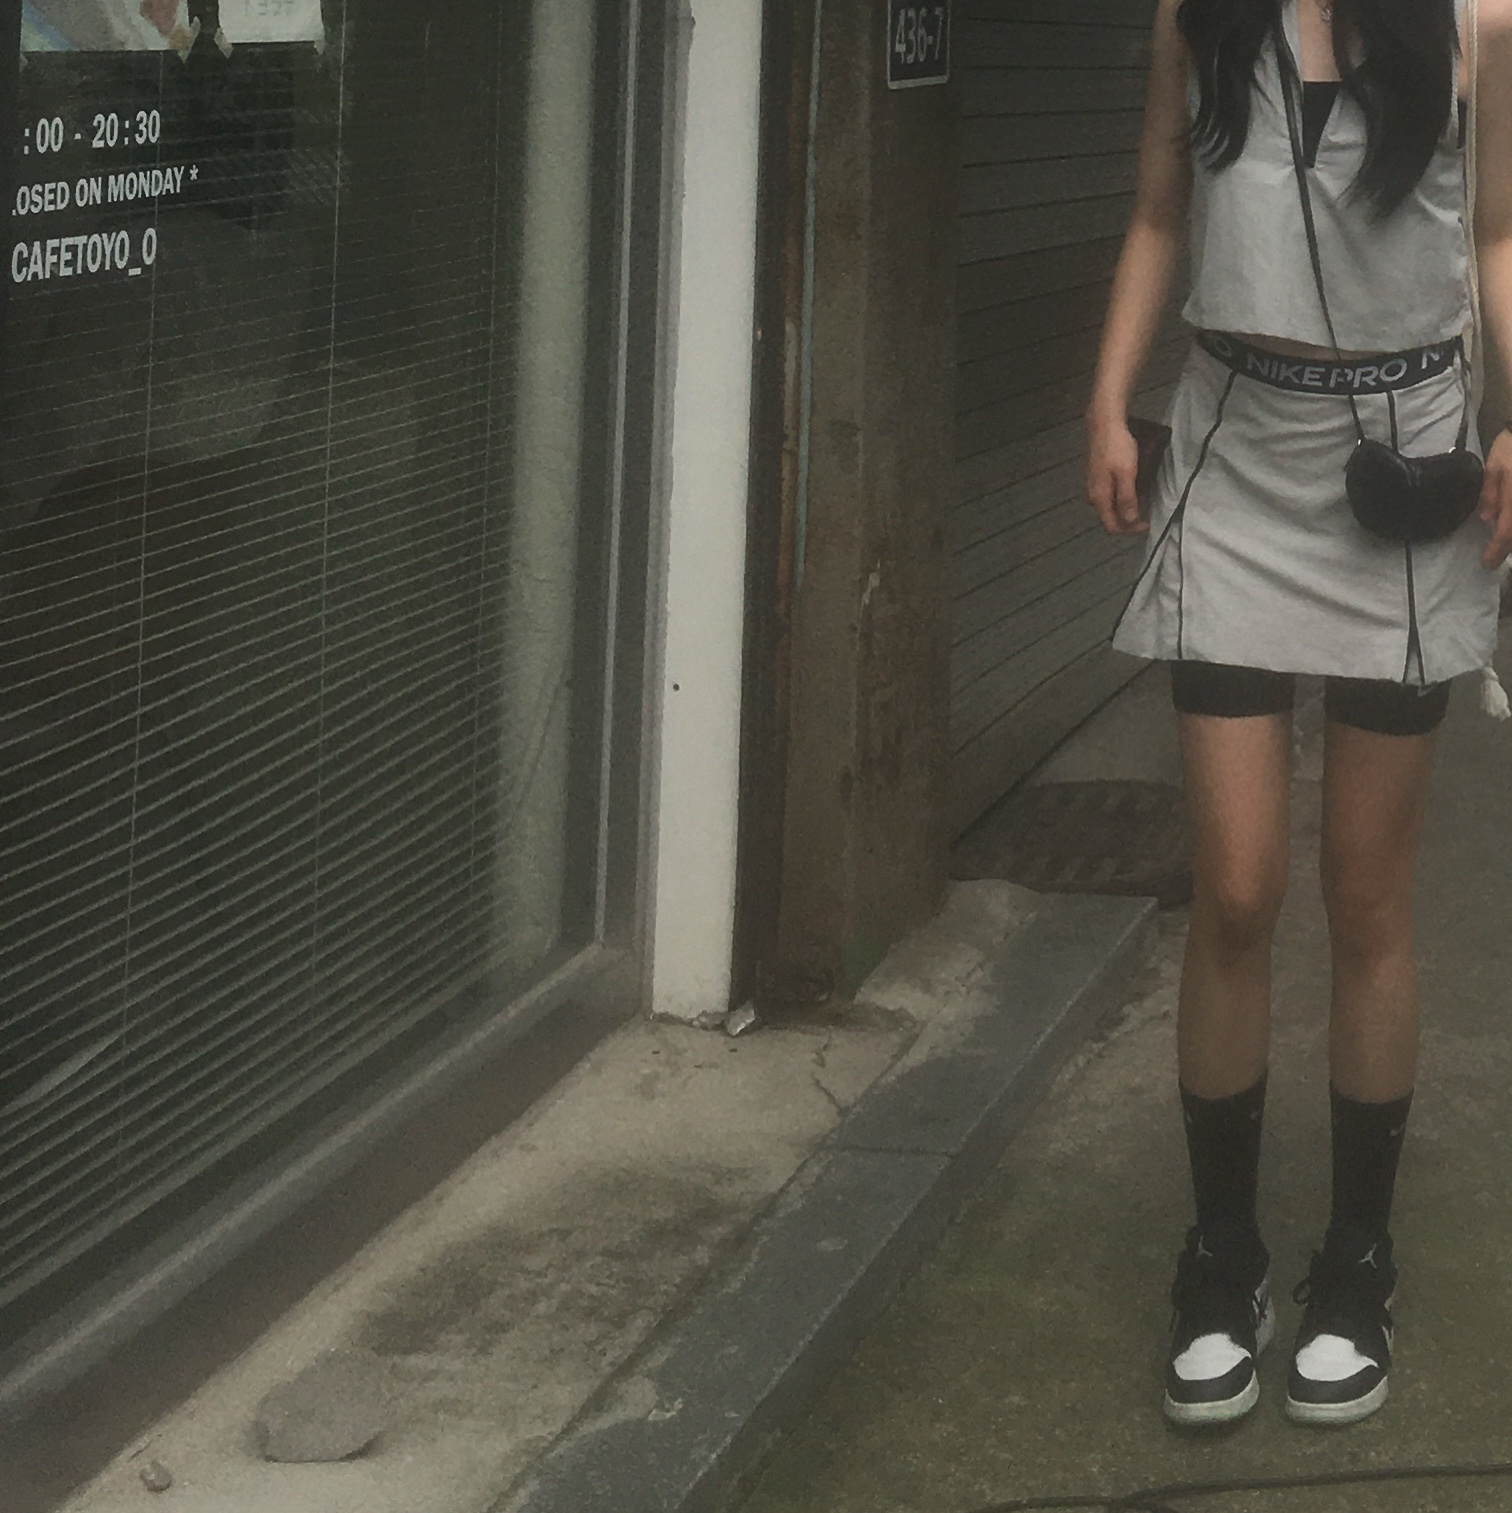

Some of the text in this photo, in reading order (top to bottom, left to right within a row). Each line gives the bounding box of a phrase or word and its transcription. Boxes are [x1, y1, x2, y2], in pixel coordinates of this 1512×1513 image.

[894, 6, 945, 65] 436-7
[92, 109, 161, 149] 20:30
[11, 165, 185, 216] OSED ON MONDAY
